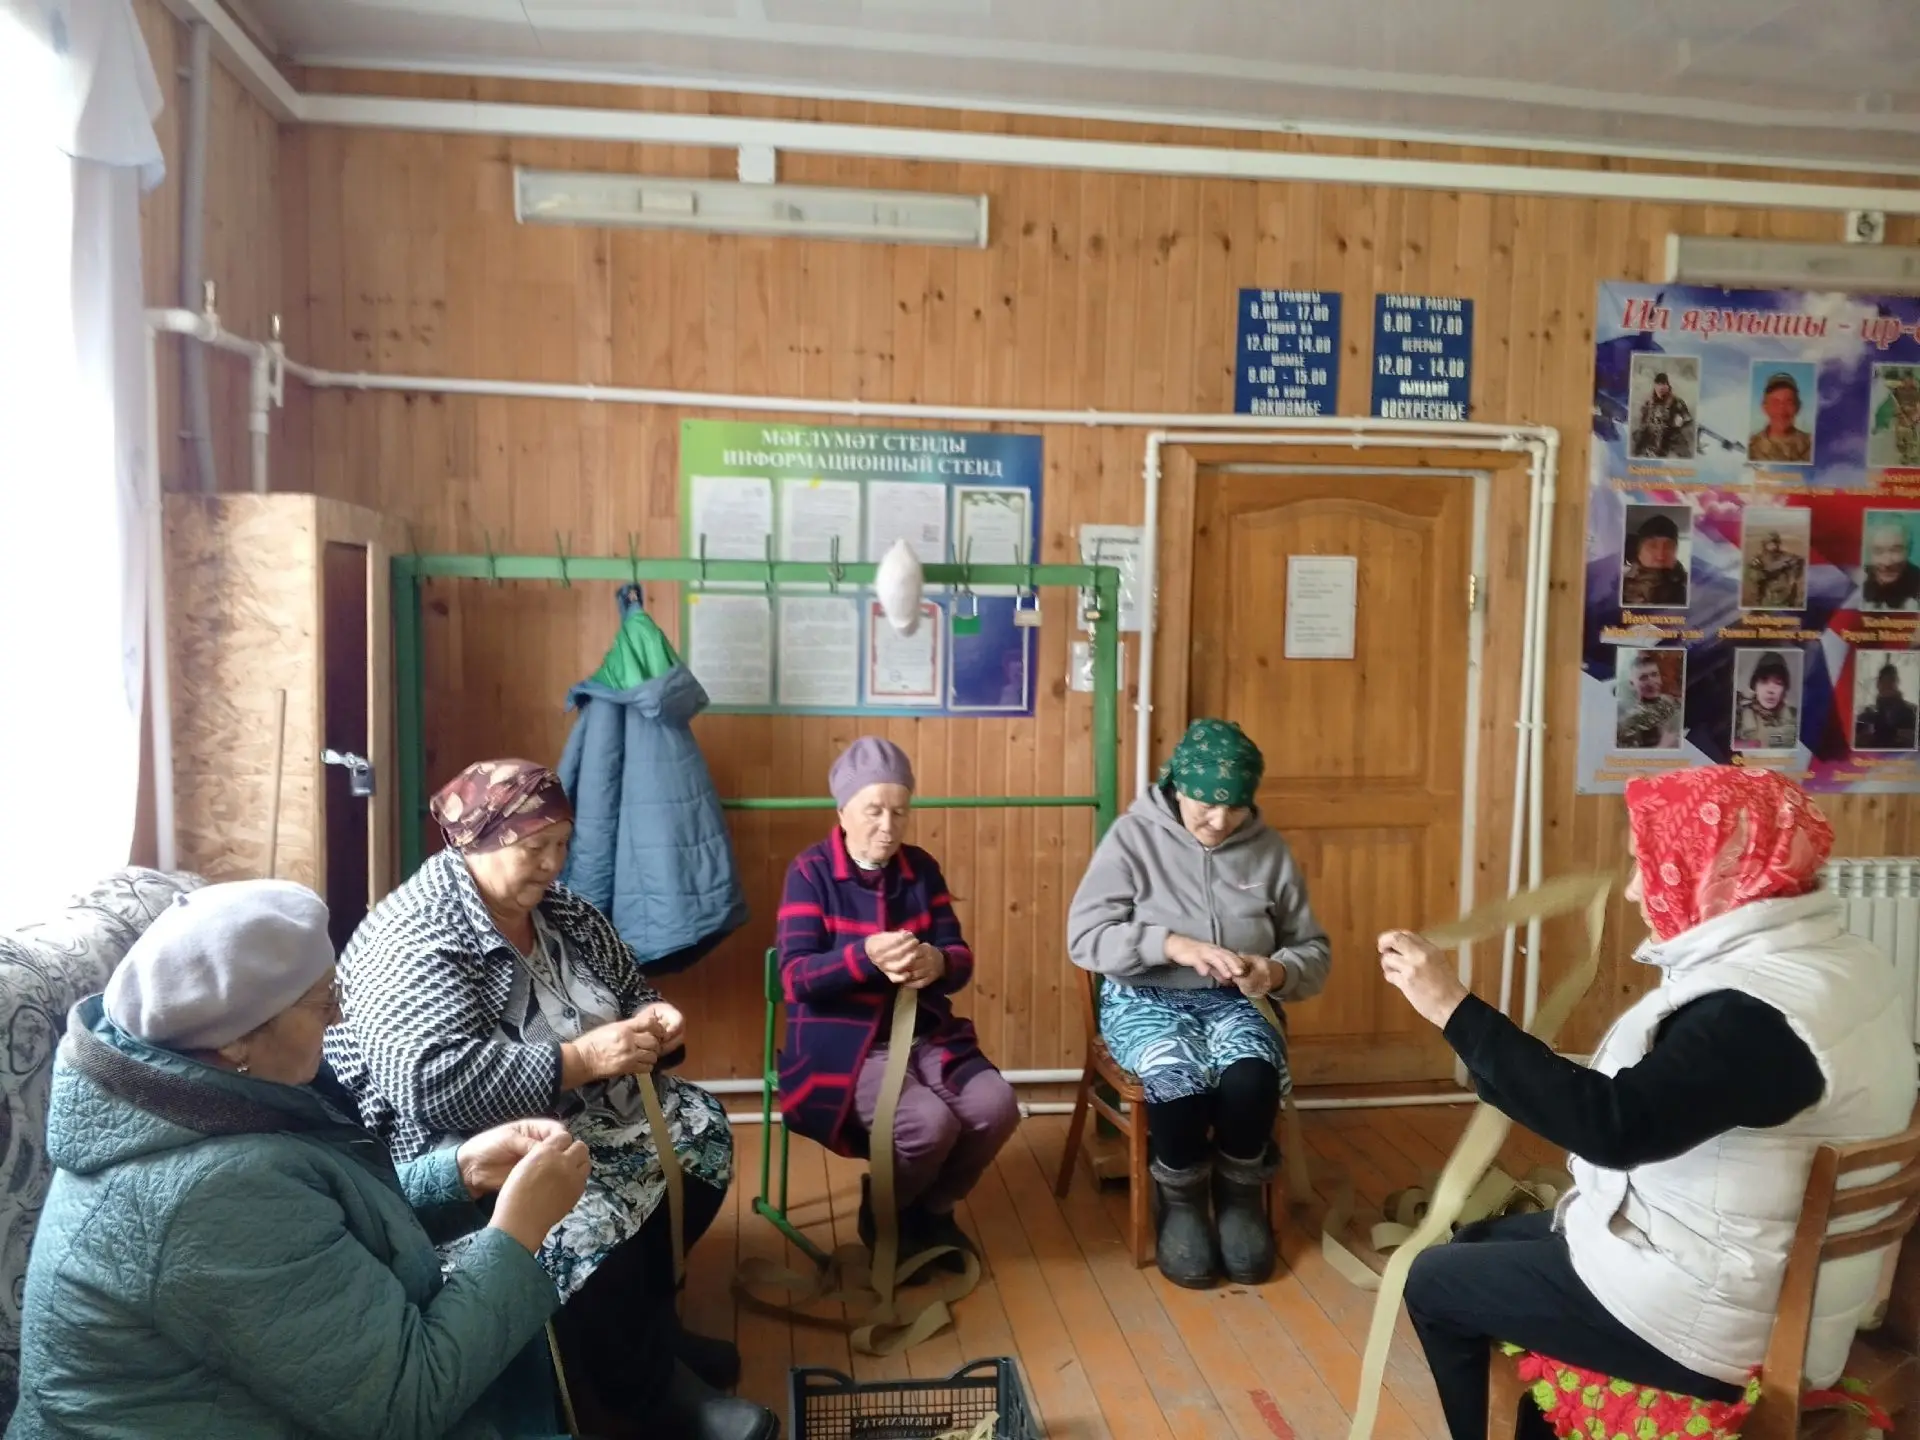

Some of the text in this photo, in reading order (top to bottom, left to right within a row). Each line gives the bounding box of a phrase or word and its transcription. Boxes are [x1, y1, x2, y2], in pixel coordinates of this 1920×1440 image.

[1298, 303, 1329, 322] 17.00
[1425, 295, 1462, 312] РАБОТЫ
[1429, 313, 1463, 336] 17.00
[1246, 333, 1279, 352] 12.00
[1299, 335, 1331, 353] 14.00
[1378, 355, 1413, 376] 12.00
[1429, 357, 1465, 378] 14.00
[1400, 380, 1450, 398] ВЫХОДНОЙ
[1381, 397, 1466, 421] ВОСКРЕСЕНЬЕ
[883, 432, 967, 455] СТЕНДЫ
[722, 448, 1004, 478] ИНФОРМАЦИОННЫЙ СТЕНД
